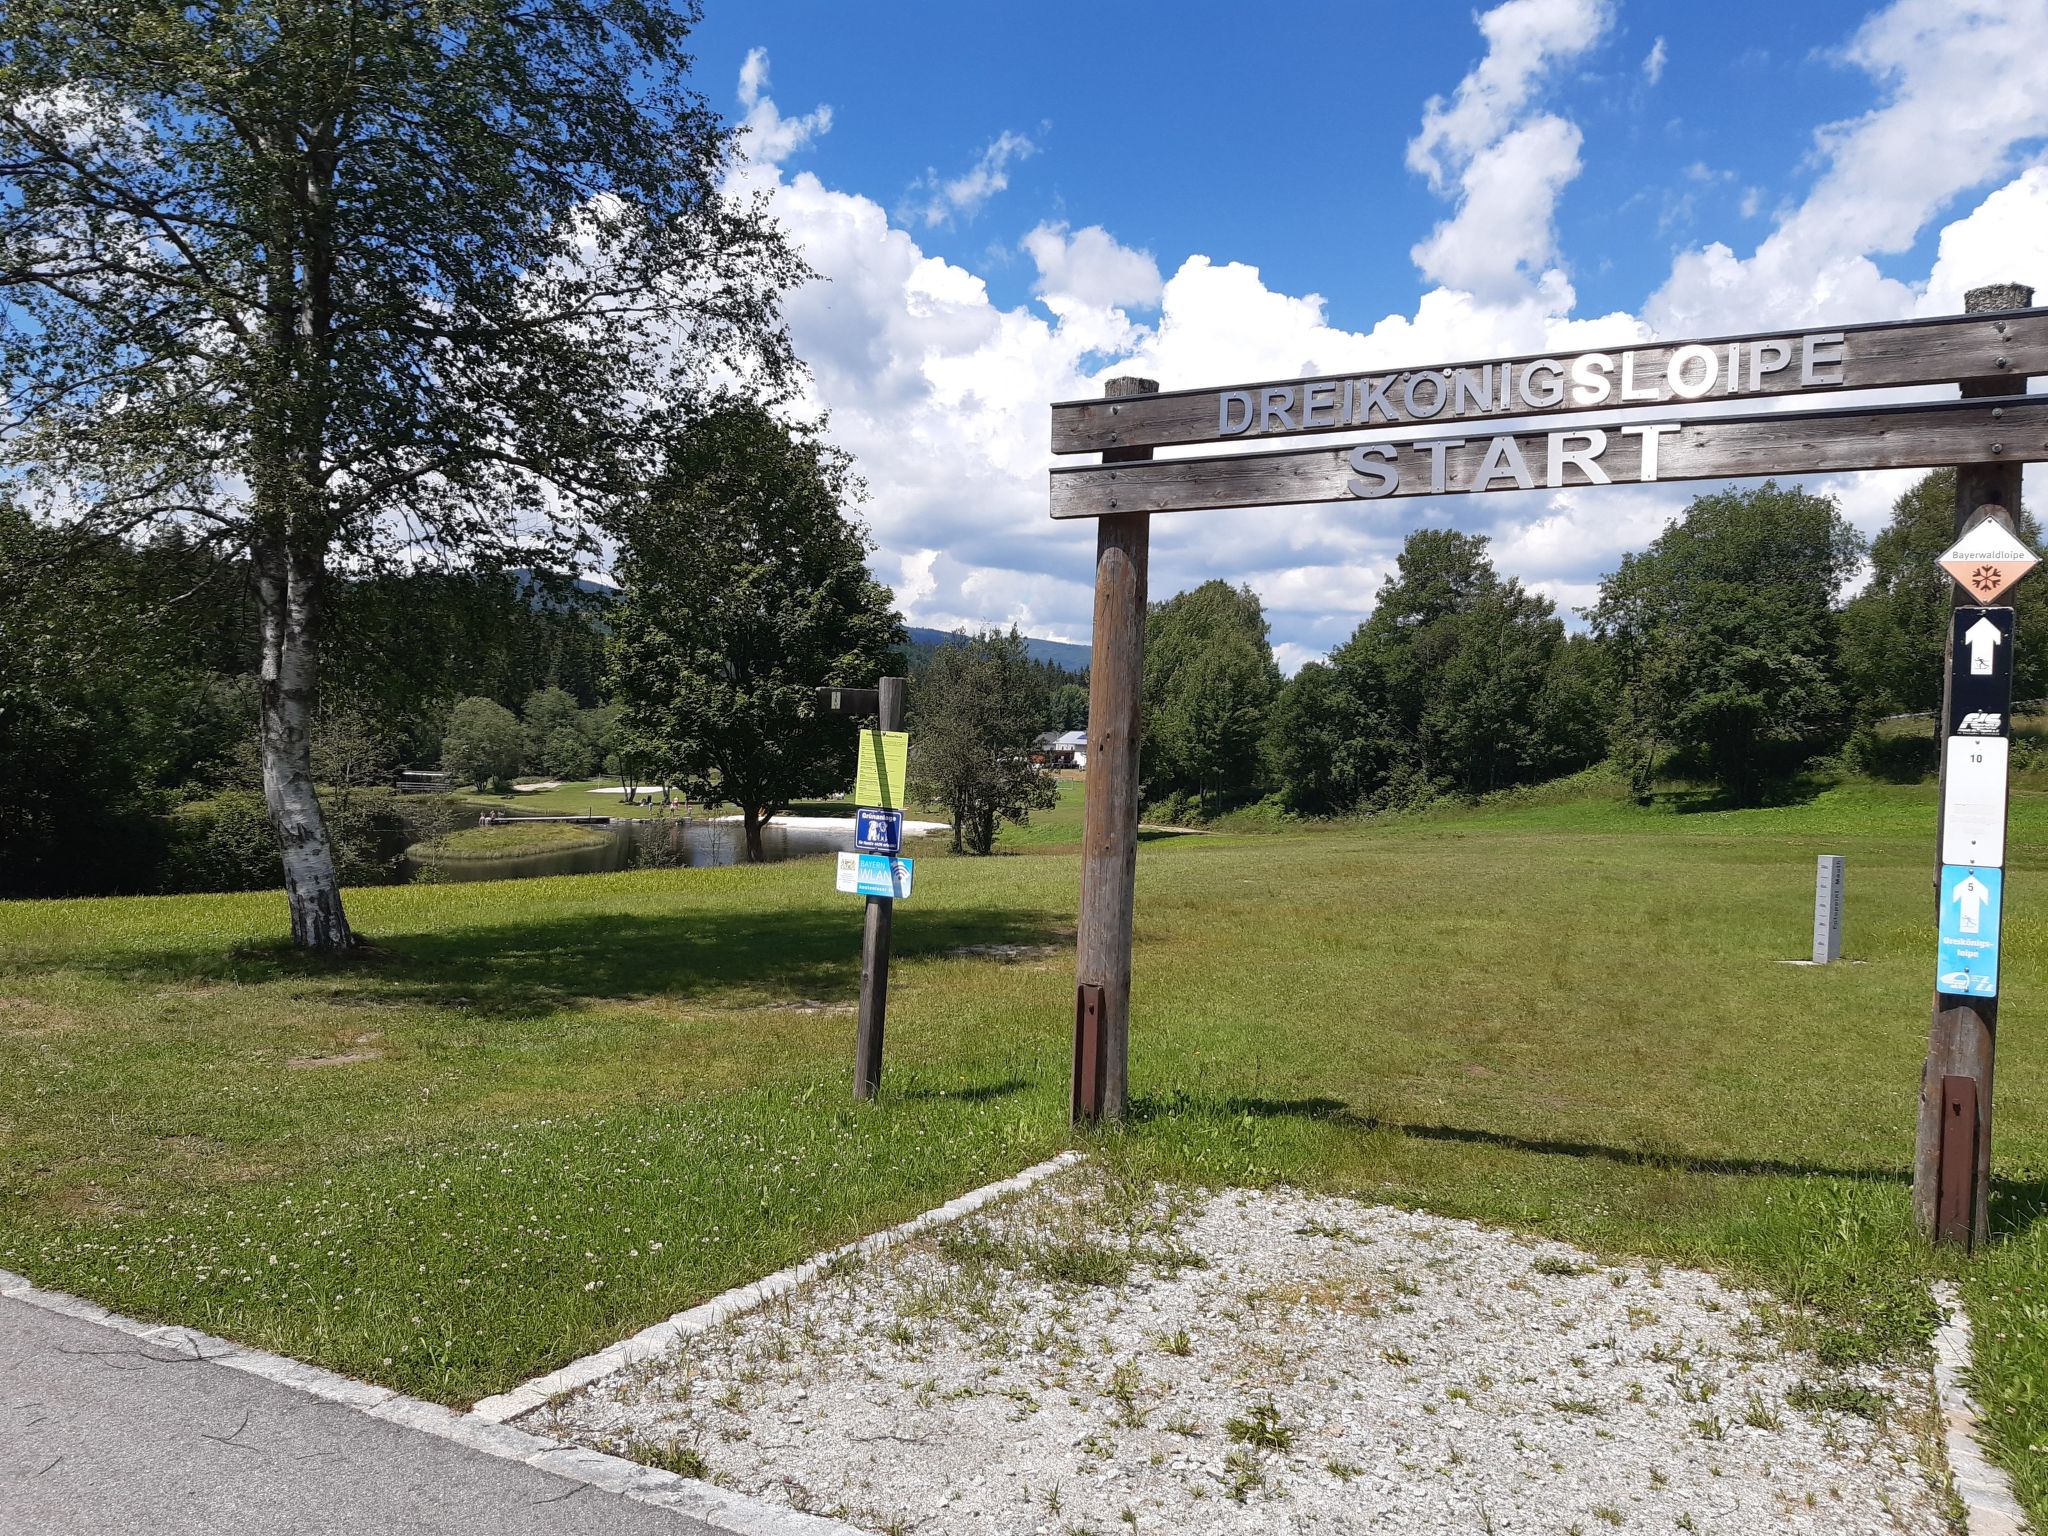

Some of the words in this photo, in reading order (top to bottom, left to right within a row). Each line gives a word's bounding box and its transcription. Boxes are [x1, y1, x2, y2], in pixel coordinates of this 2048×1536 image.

[1219, 332, 1845, 436] DREIKÖNIGSLOIPE
[1348, 422, 1681, 498] START
[1952, 551, 2025, 560] Bayerwaldloipe
[1970, 754, 1983, 763] 10
[862, 812, 897, 822] Grünanlage
[860, 861, 886, 869] BAYERN
[860, 868, 892, 881] WLAN
[1967, 883, 1974, 891] 5
